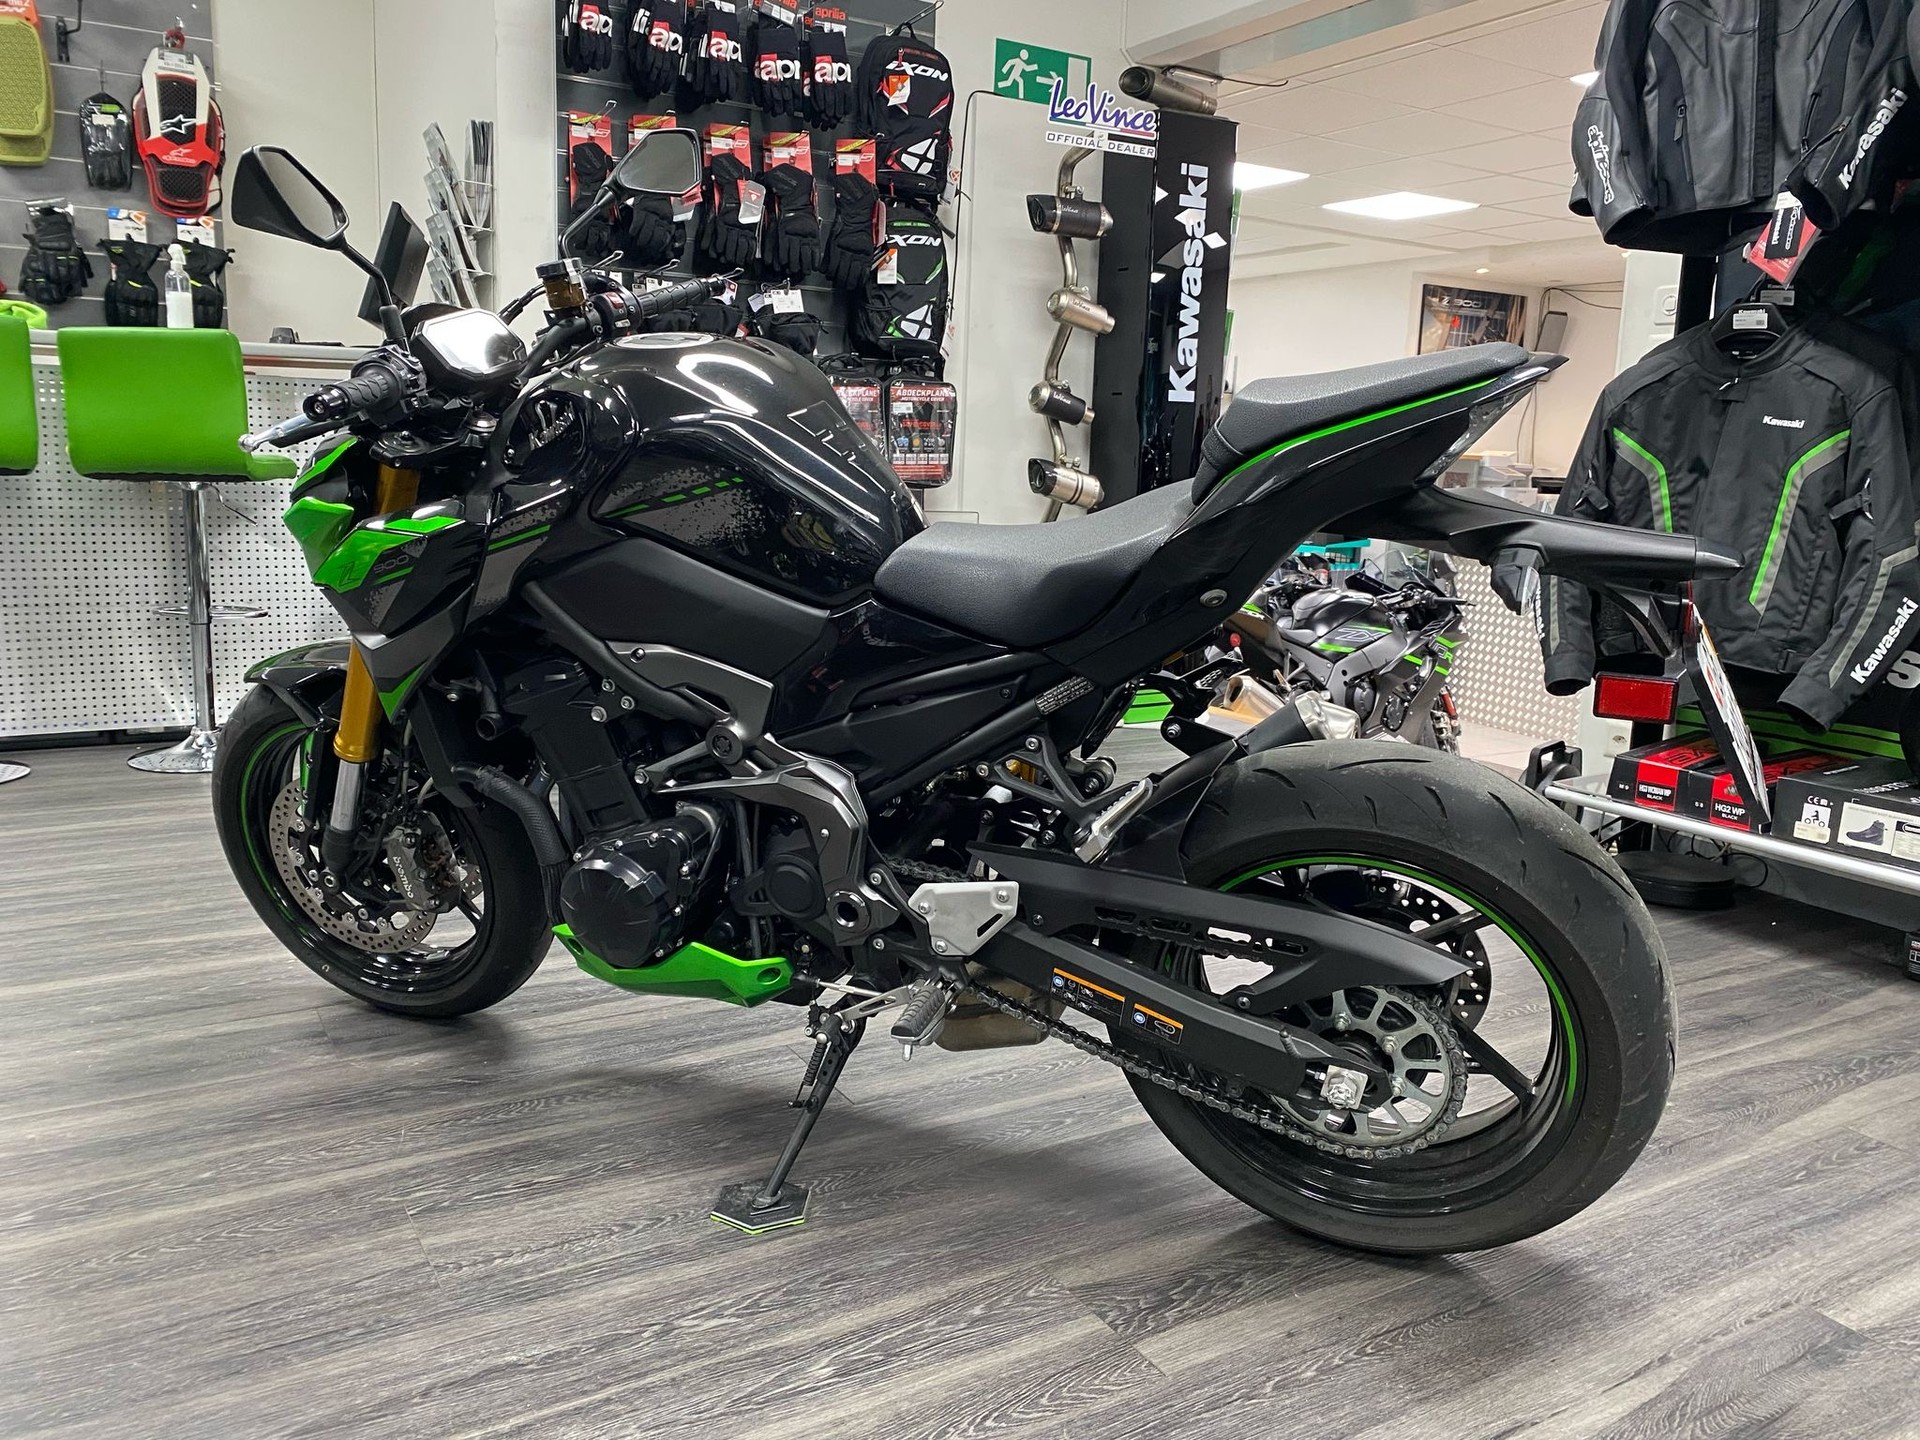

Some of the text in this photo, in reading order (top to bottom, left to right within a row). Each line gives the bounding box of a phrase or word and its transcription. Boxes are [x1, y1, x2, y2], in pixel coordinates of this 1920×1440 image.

[815, 7, 846, 21] aprilia
[1050, 79, 1156, 132] LeoVince
[1047, 133, 1155, 157] OFFICIAL DEALER
[1168, 162, 1209, 404] Kawasaki
[1762, 415, 1806, 429] Kawasaki
[1850, 596, 1919, 684] Kawasaki
[1715, 803, 1746, 816] HG2 WP
[1721, 813, 1739, 821] BLACK
[393, 856, 414, 899] brembo
